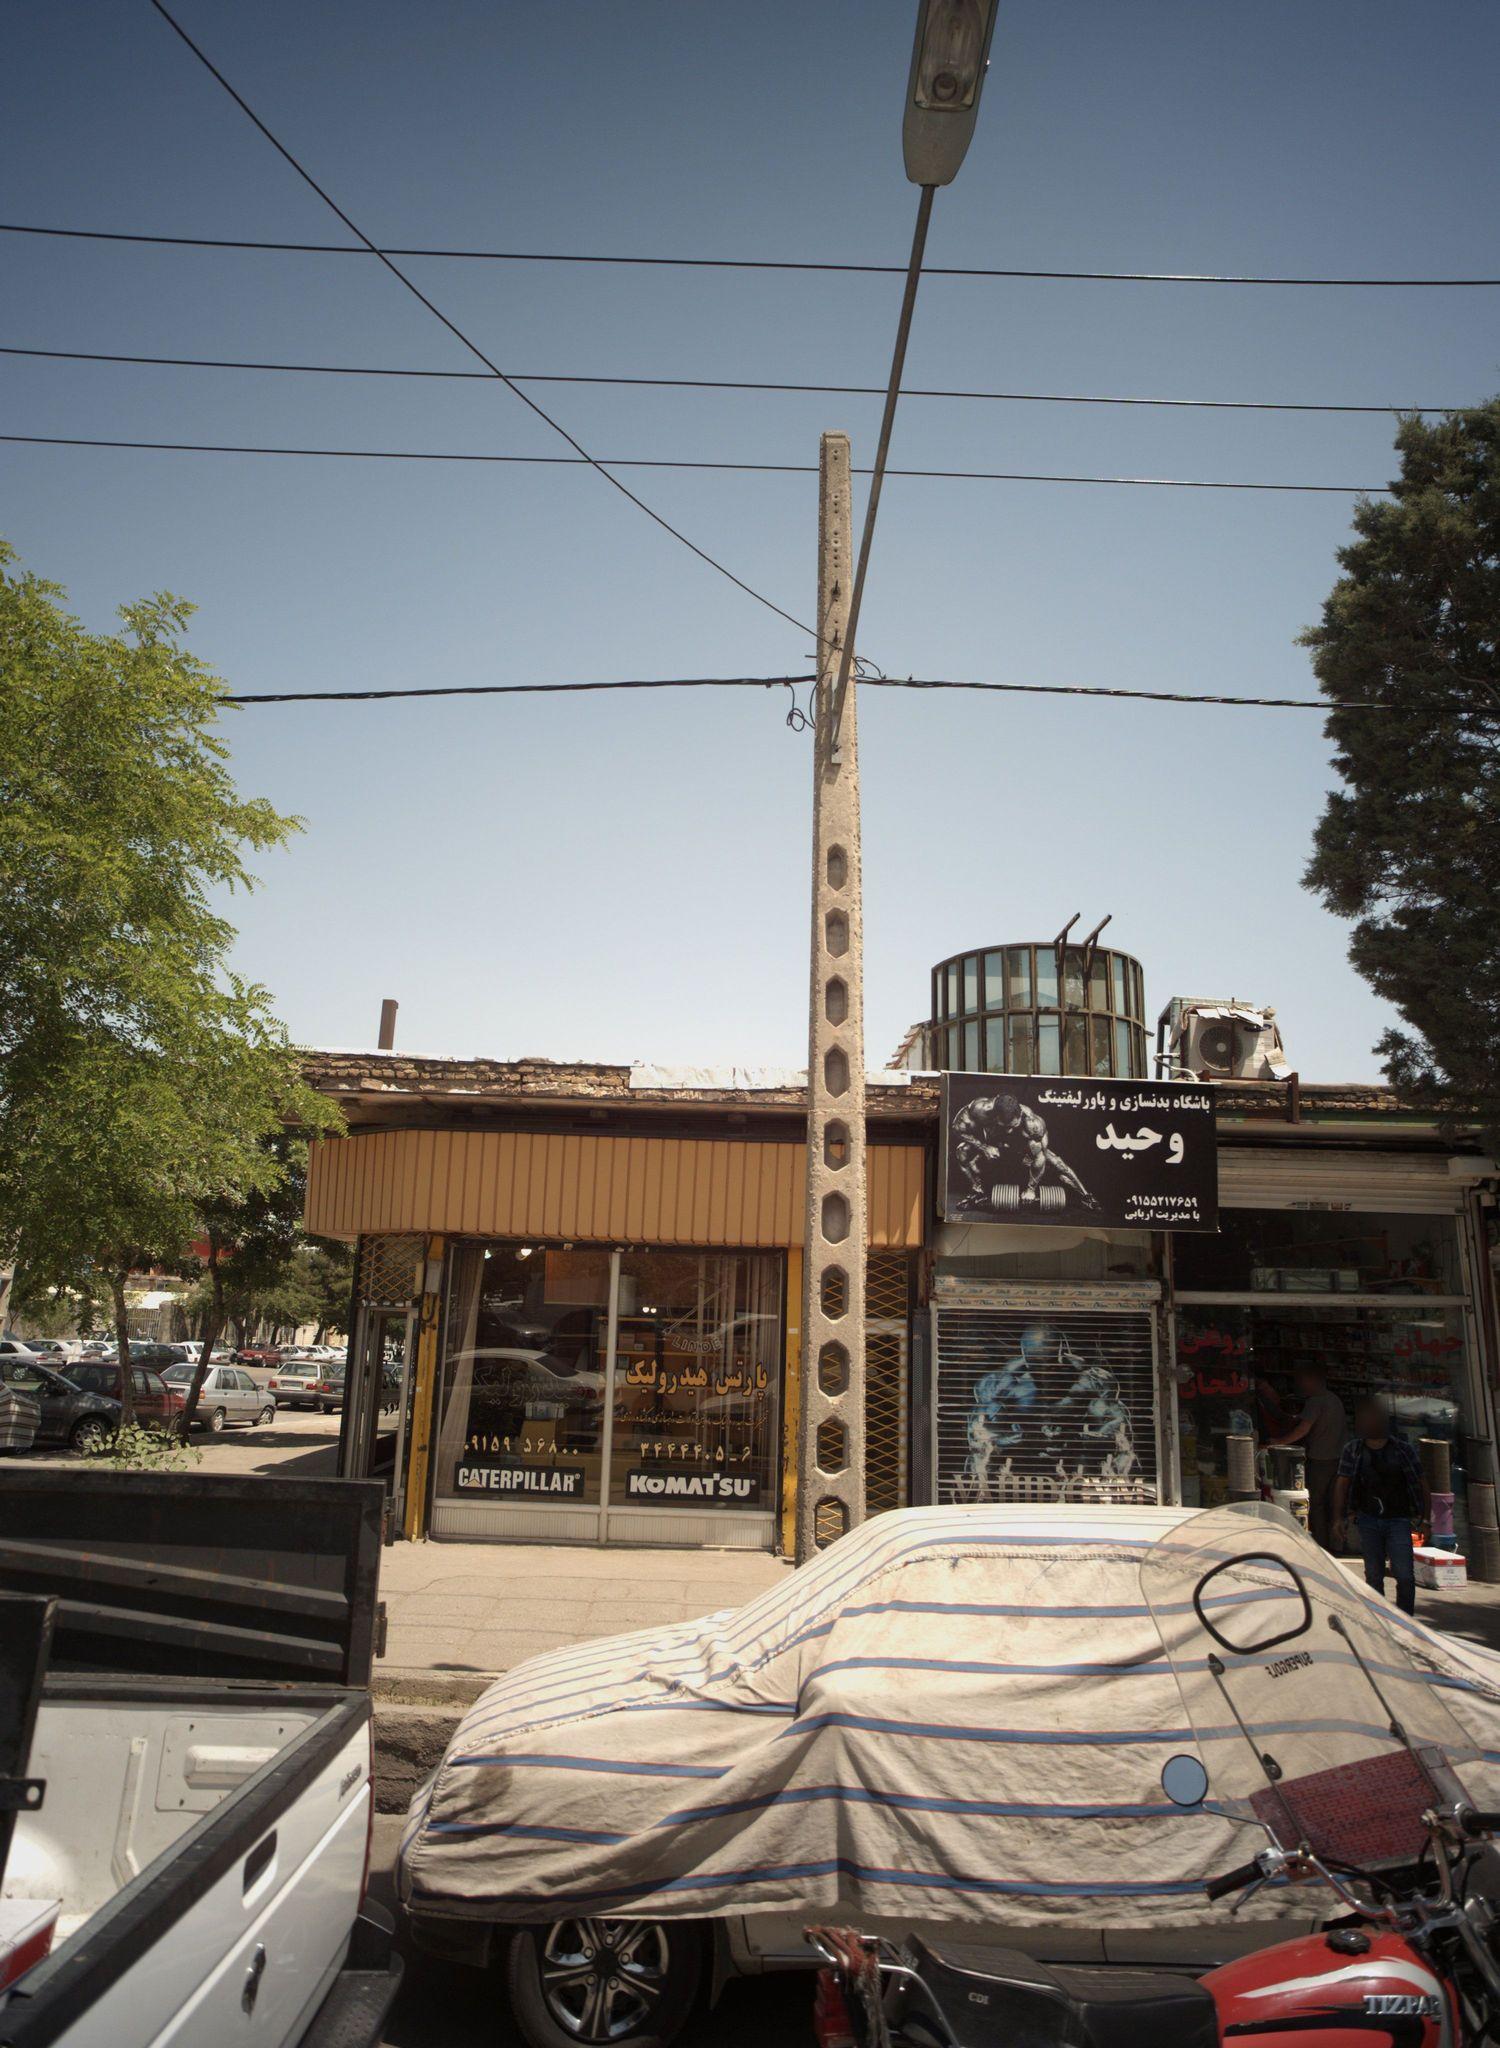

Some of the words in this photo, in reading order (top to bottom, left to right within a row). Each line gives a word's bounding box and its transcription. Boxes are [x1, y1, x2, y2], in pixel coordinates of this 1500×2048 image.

[1109, 1098, 1117, 1110] و
[1119, 1092, 1170, 1112] بدنسازی
[1173, 1094, 1210, 1113] باشگاه
[1096, 1122, 1184, 1164] وحید
[1155, 1210, 1191, 1222] مدیریت
[1192, 1210, 1200, 1222] با
[626, 1359, 707, 1396] هیدرولیک
[715, 1359, 767, 1400] پارتس
[967, 1991, 989, 2005] CDI
